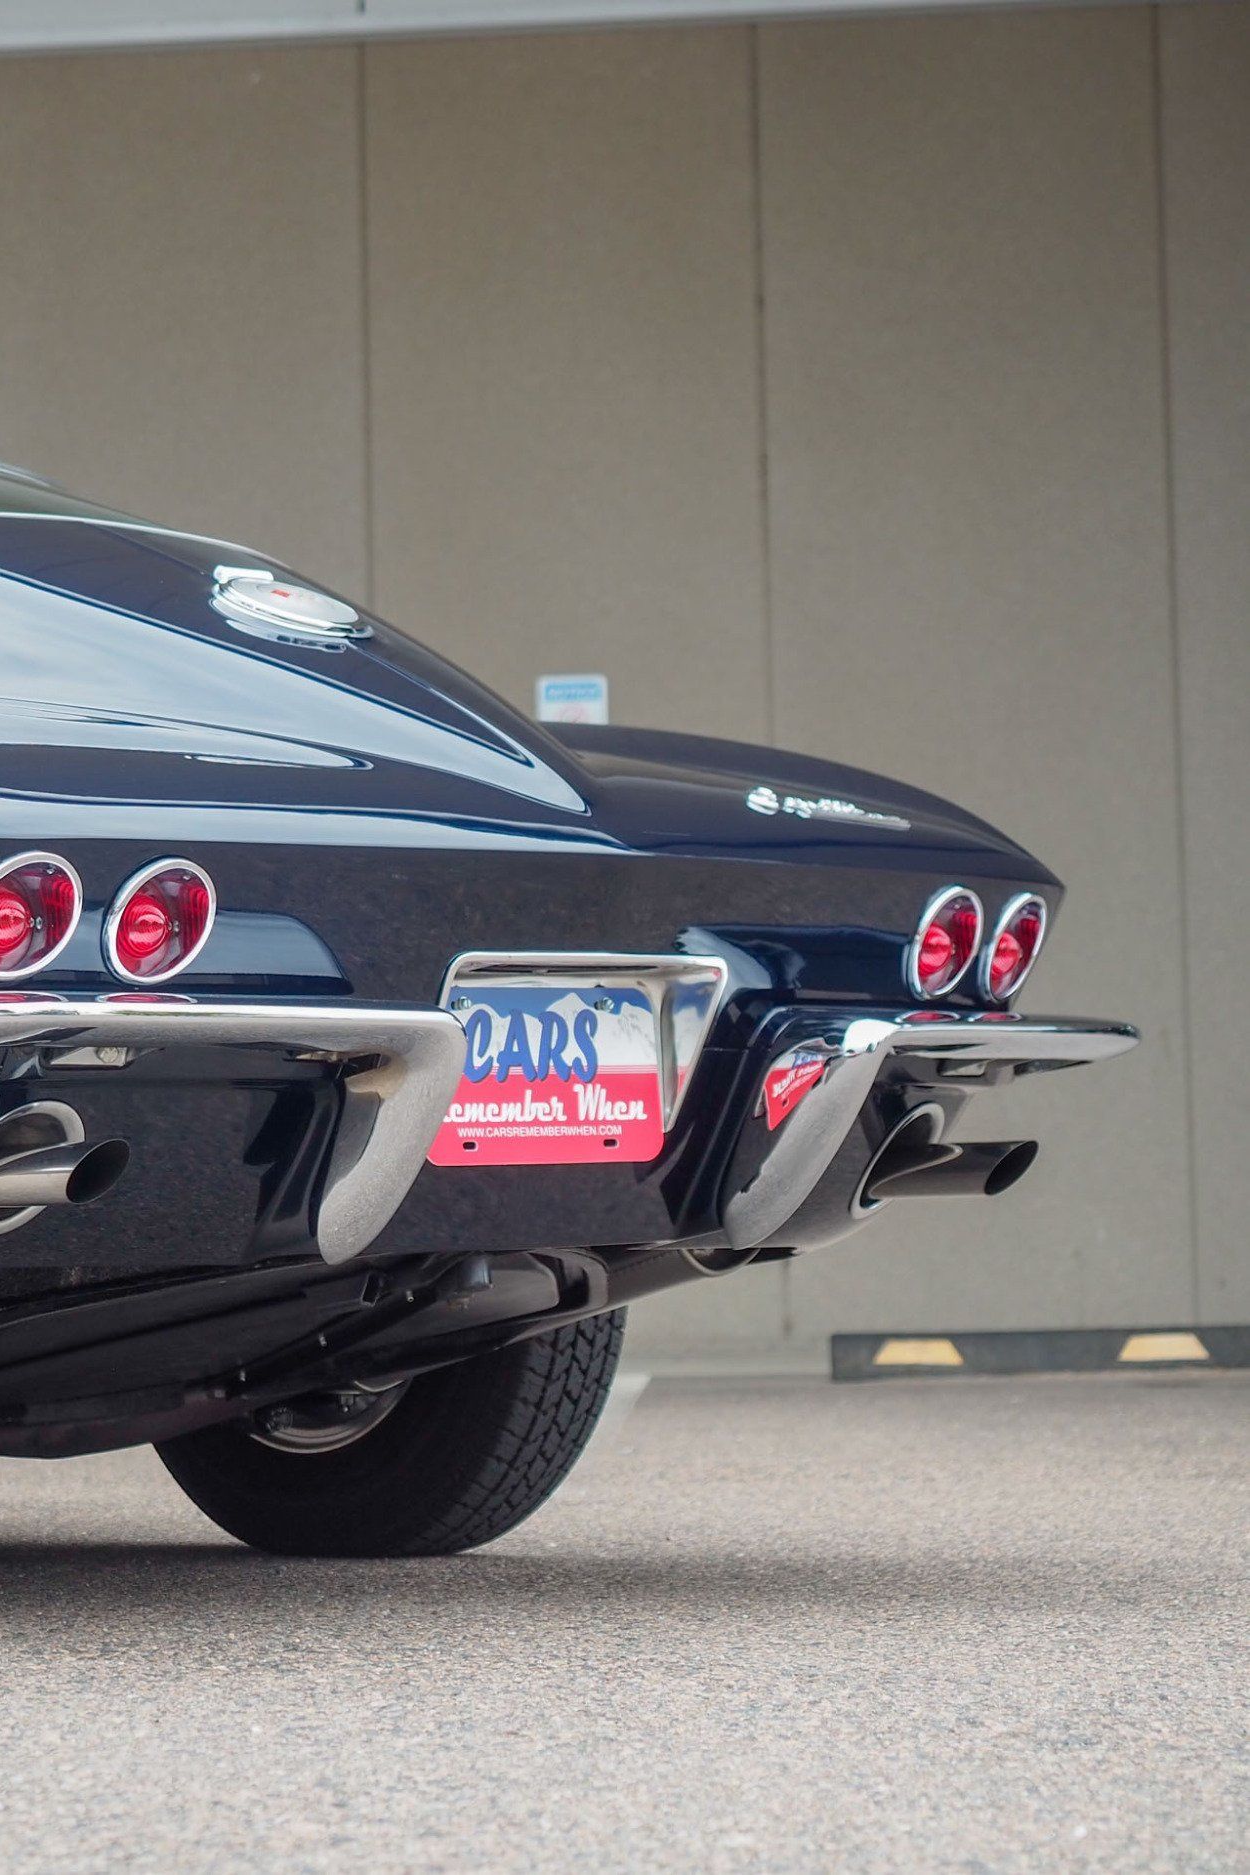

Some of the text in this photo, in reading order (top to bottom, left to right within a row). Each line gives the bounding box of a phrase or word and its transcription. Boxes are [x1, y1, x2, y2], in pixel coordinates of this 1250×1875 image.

[464, 1008, 598, 1083] CARS
[444, 1083, 647, 1122] emember When
[457, 1125, 622, 1138] WWW.CARSREMEMBERWHEN.COM
